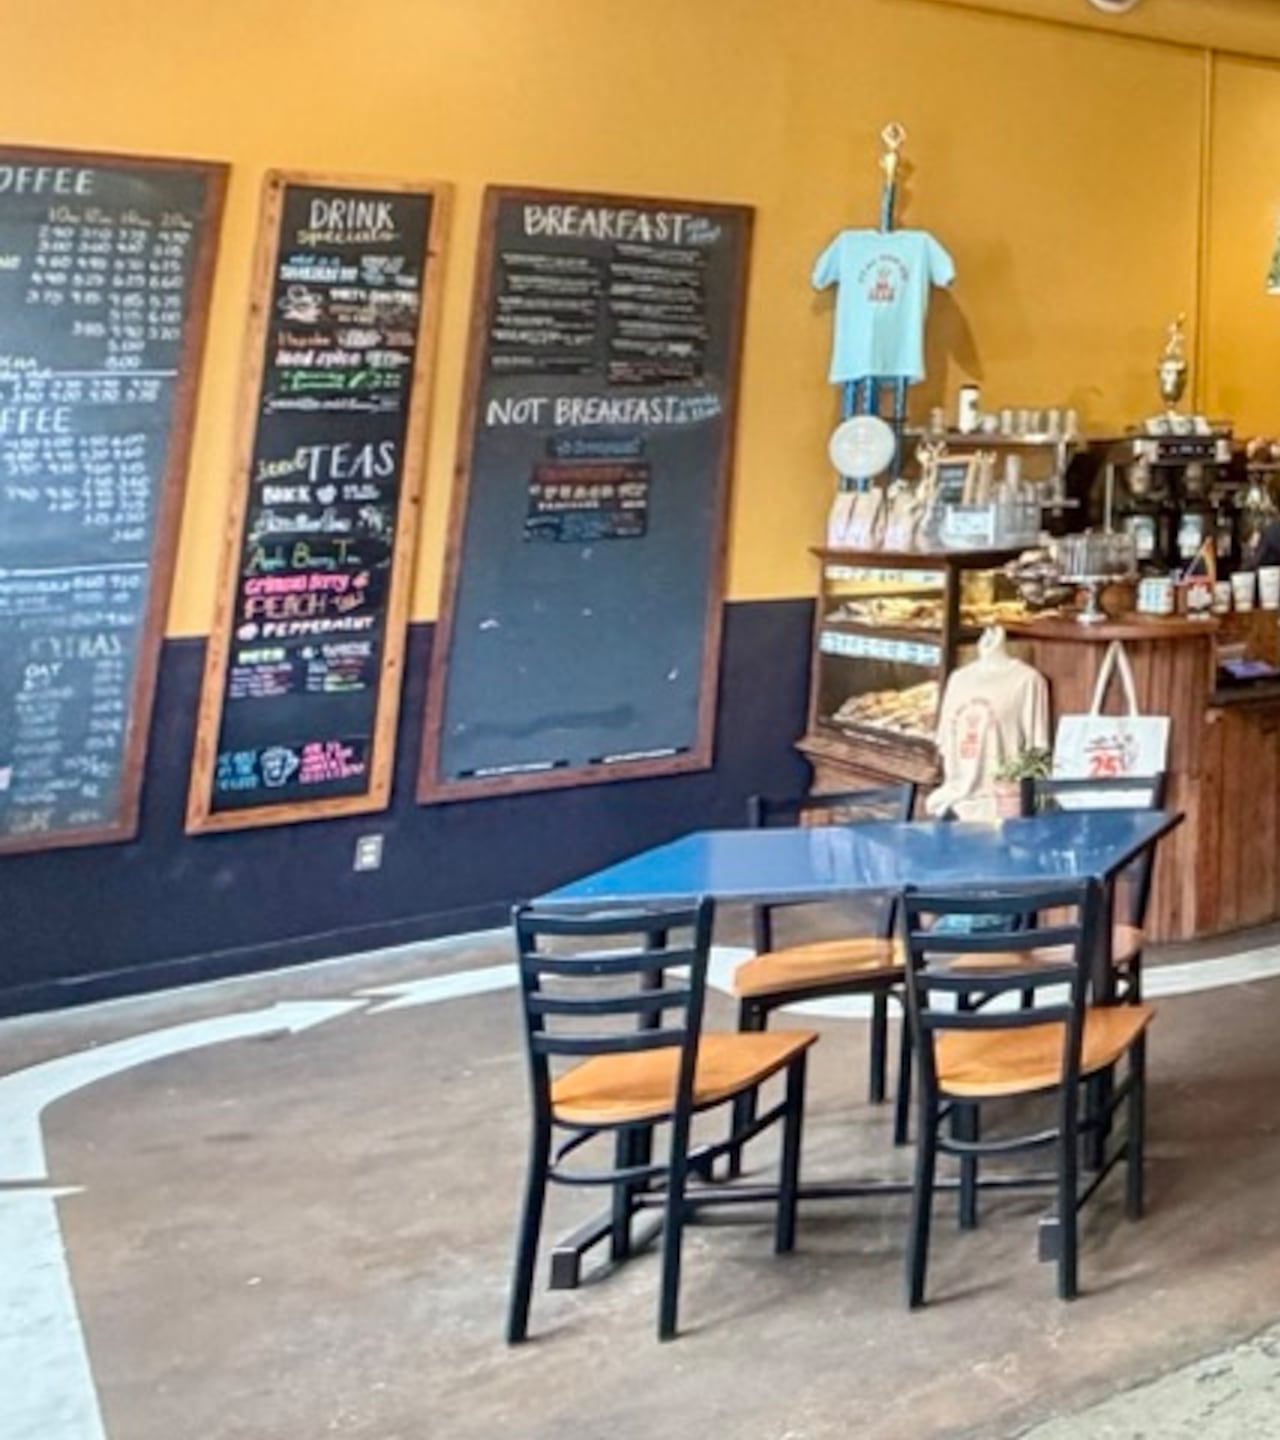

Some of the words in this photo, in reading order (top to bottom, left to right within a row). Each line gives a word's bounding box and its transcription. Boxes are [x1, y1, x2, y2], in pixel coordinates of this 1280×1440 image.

[309, 199, 395, 229] DRINK
[523, 205, 691, 243] BREAKFAST
[486, 398, 548, 426] NOT
[554, 397, 676, 427] BREAKFAST
[307, 441, 396, 483] TEAS
[261, 616, 374, 638] PEPPERMINT
